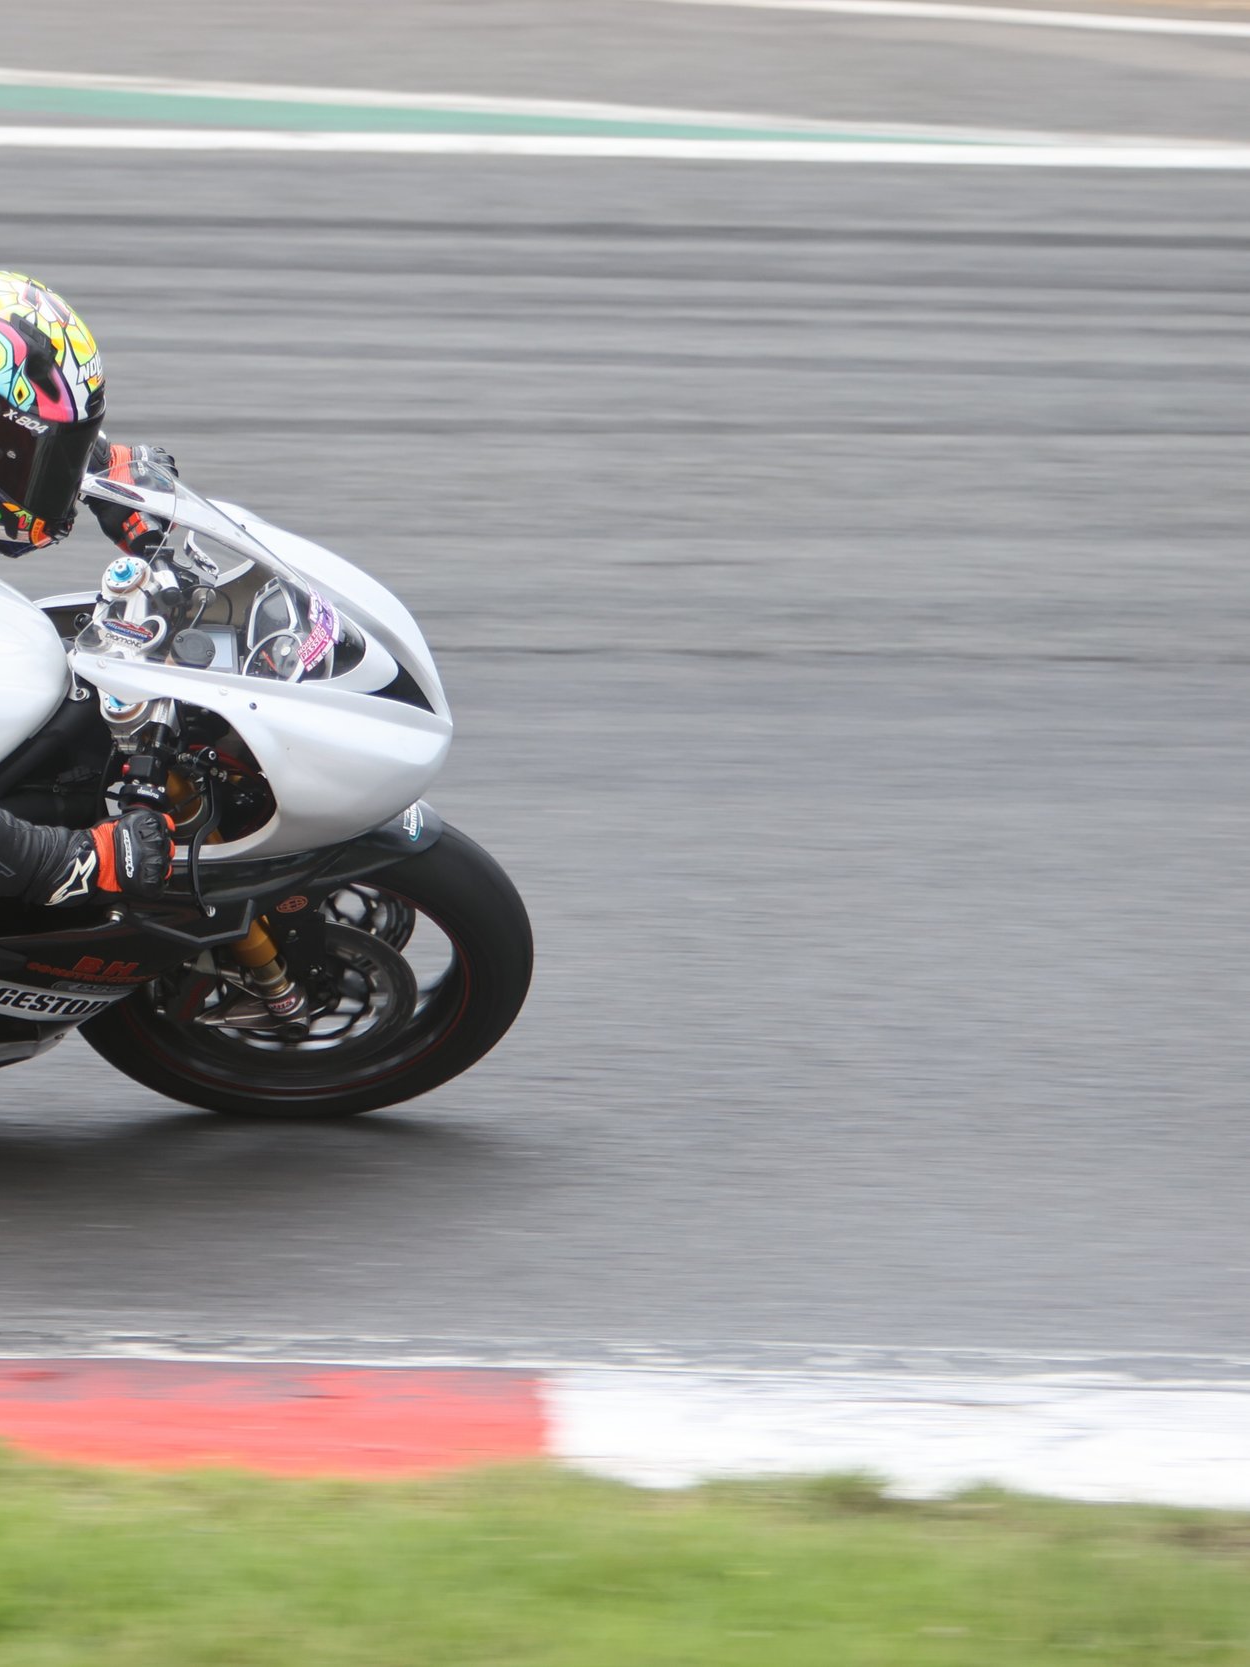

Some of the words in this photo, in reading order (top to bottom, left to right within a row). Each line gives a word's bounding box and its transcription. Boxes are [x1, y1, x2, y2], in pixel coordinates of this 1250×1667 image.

[77, 351, 102, 384] NOL
[3, 409, 49, 434] X-804
[297, 637, 314, 656] NOISE
[301, 630, 327, 660] PASSED
